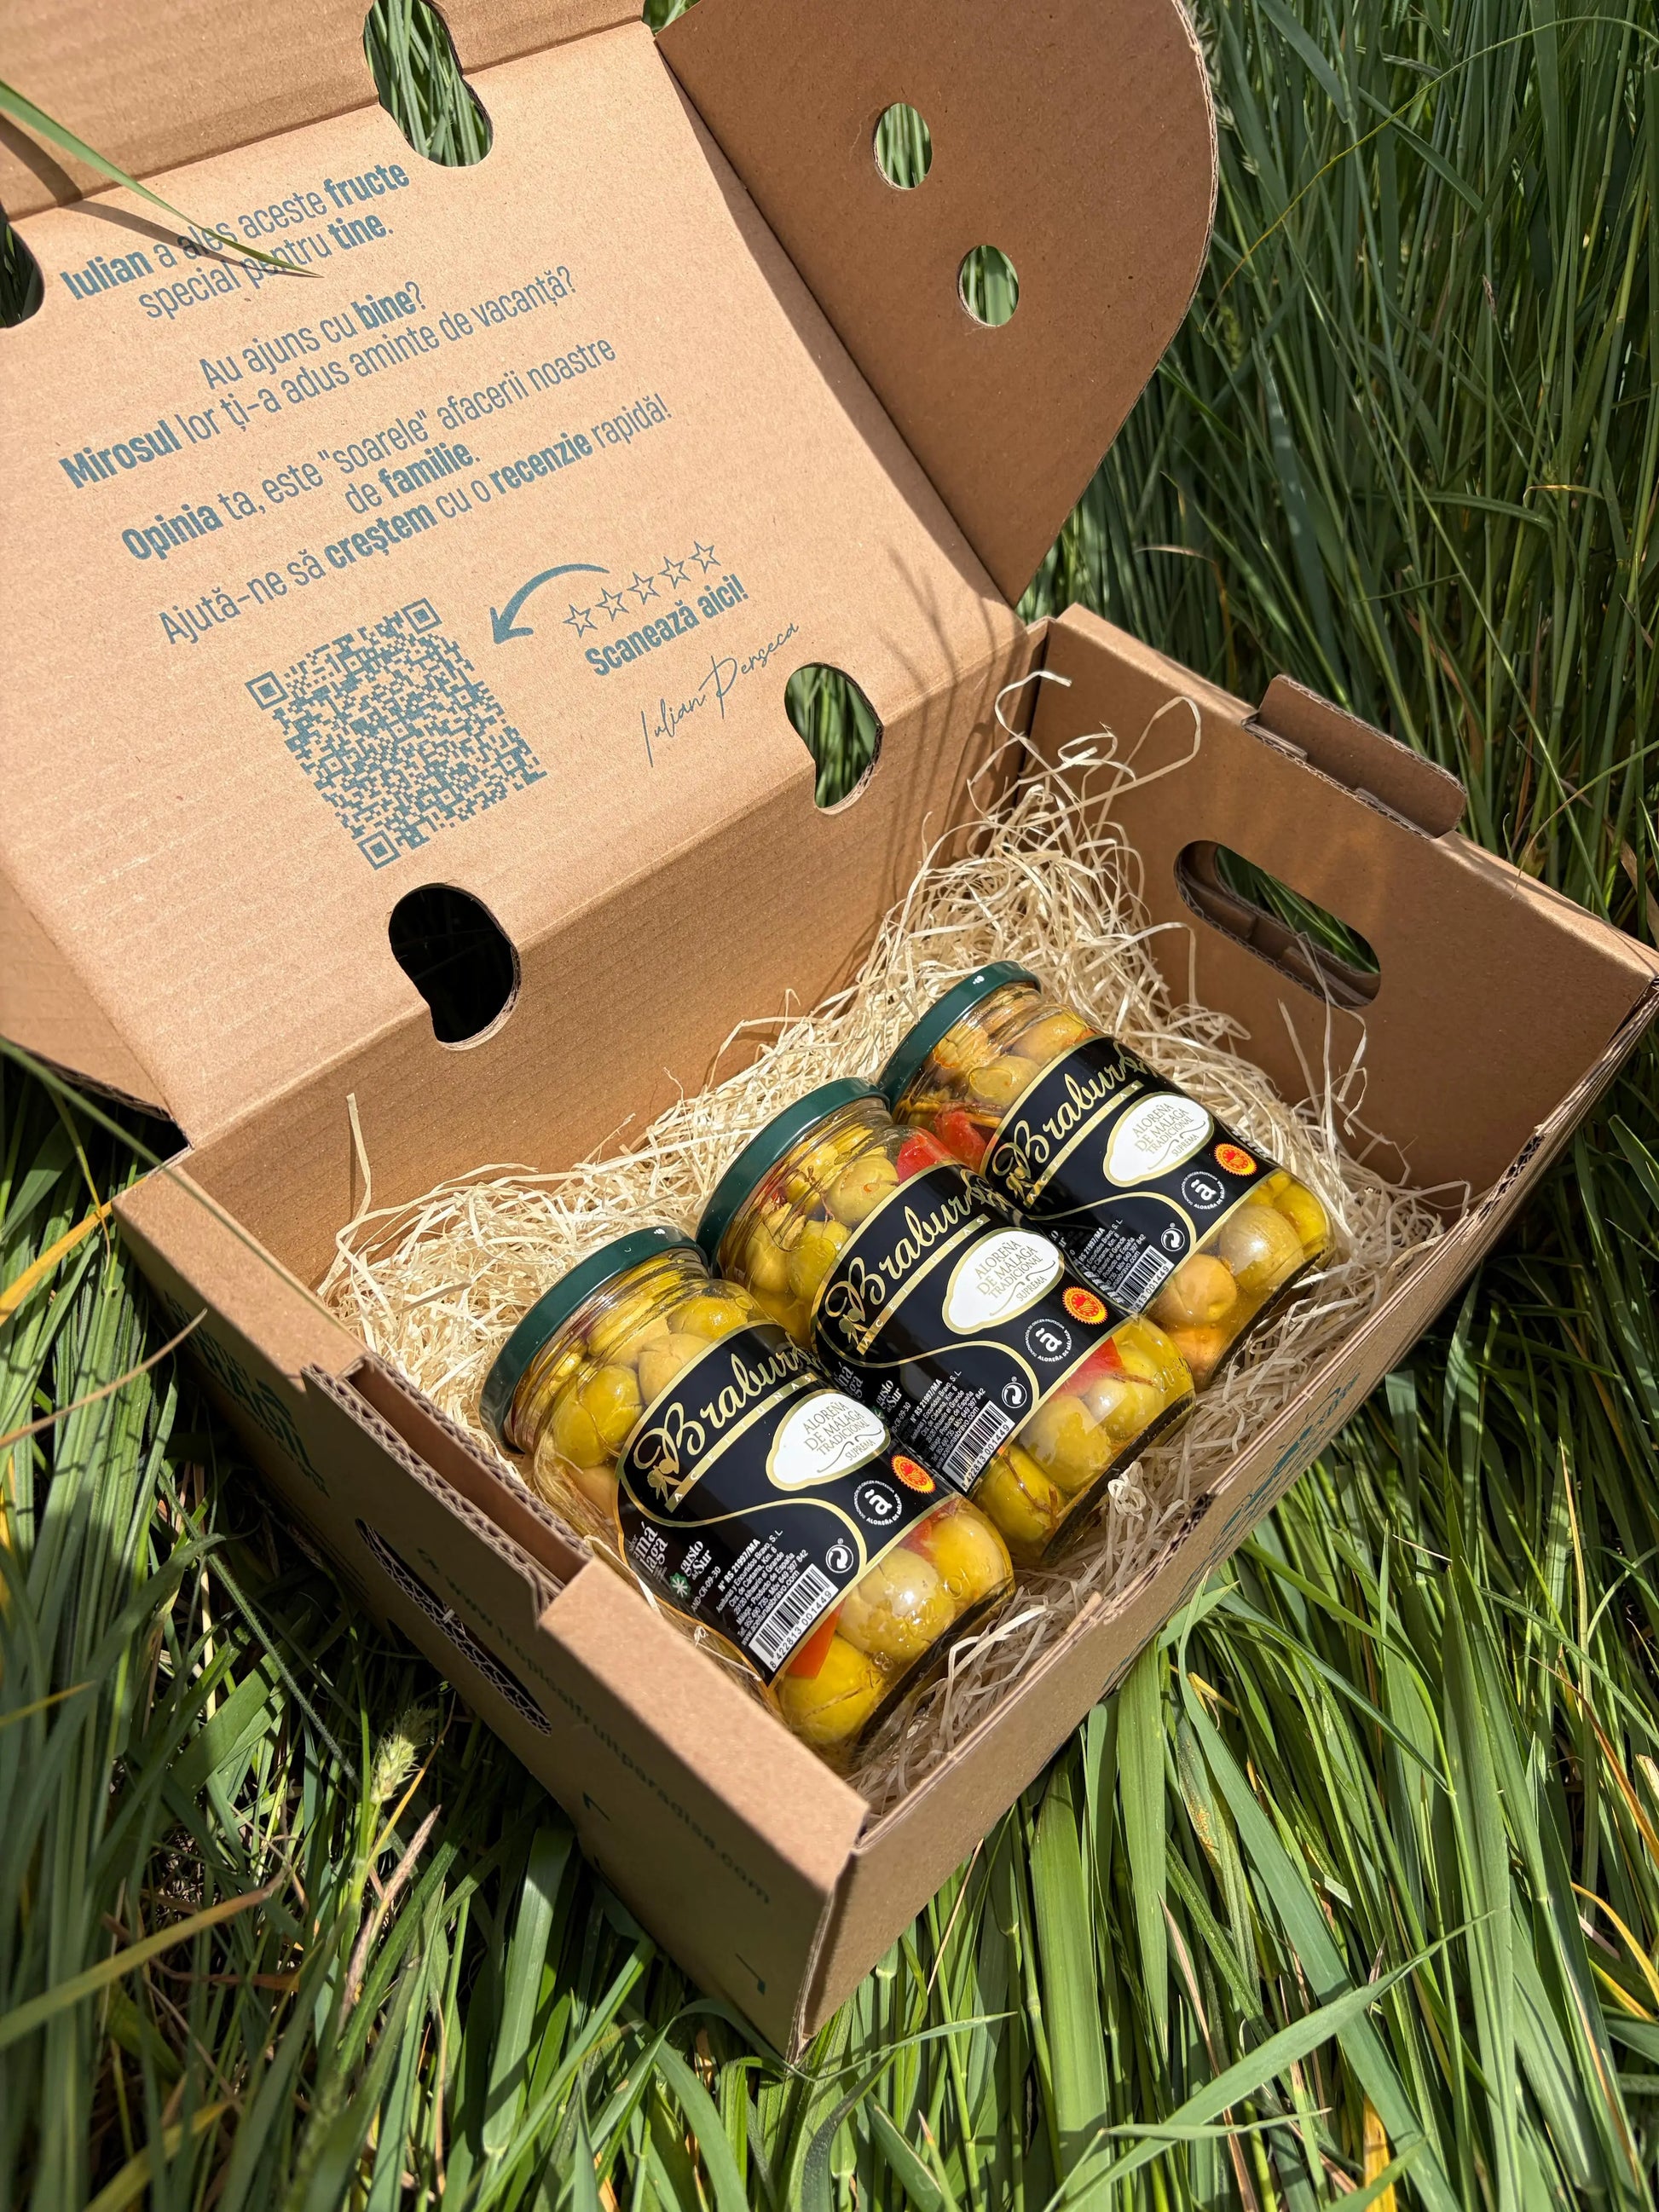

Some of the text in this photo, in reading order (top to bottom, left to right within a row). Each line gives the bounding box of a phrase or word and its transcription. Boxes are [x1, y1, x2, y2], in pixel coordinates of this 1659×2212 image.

[60, 164, 410, 300] Iulian a ales aceste fructe
[139, 212, 394, 320] special pentru tine.
[199, 281, 427, 390] Au ajuns cu bine?
[58, 420, 182, 489] Mirosul
[175, 407, 223, 445] lor
[280, 359, 350, 406] adus
[349, 322, 441, 378] aminte
[438, 310, 474, 342] de
[121, 338, 616, 560] Opinia ta, este "soarele" afacerii noastre
[344, 441, 481, 514] de familie.
[159, 570, 288, 645] Ajută-ne
[286, 548, 327, 586] să
[436, 488, 473, 520] cu
[471, 479, 492, 504] o
[488, 432, 593, 496] recenzie
[590, 392, 673, 450] rapidă!
[584, 574, 749, 676] Scanează aici!
[1131, 1102, 1173, 1138] ALOREÑA
[1135, 1108, 1190, 1152] DE MÁLAGA
[1146, 1115, 1195, 1154] TRADICIONAL
[1173, 1134, 1200, 1158] SUPREMA
[974, 1239, 1022, 1279] ALOREÑA
[1136, 1233, 1146, 1245] 842
[977, 1246, 1038, 1295] DE MÁLAGA
[988, 1255, 1044, 1300] TRADICIONAL
[1015, 1275, 1048, 1302] SUPREMA
[1147, 1265, 1170, 1293] 001449
[876, 1380, 893, 1409] gusto
[886, 1388, 902, 1407] Sur
[939, 1415, 956, 1435] Producto
[957, 1390, 974, 1410] España
[948, 1389, 964, 1408] Grande
[966, 1397, 977, 1411] 397
[974, 1388, 986, 1400] 842
[673, 1374, 812, 1503] ACEITUNAS
[803, 1401, 847, 1435] ALOREÑA
[804, 1410, 865, 1451] DE MÁLAGA
[817, 1420, 870, 1456] TRADICIONAL
[985, 1424, 1010, 1455] 001449
[845, 1438, 876, 1462] SUPREMA
[680, 1541, 703, 1576] gusto
[694, 1550, 712, 1574] Sur
[715, 1588, 734, 1613] Aceitunas
[734, 1557, 757, 1586] Encurtidos
[754, 1542, 772, 1560] Bravo,
[724, 1570, 734, 1583] RS
[731, 1539, 760, 1573] 21997/MA
[737, 1586, 745, 1595] de
[761, 1553, 773, 1564] Km.
[744, 1577, 763, 1600] Alhaurín
[765, 1551, 784, 1573] Grande
[751, 1580, 772, 1604] Producto
[769, 1572, 777, 1582] de
[775, 1552, 795, 1574] España
[758, 1597, 771, 1611] 735
[777, 1570, 789, 1583] 649
[786, 1559, 797, 1573] 397
[795, 1549, 808, 1562] 842
[691, 1566, 720, 1611] AND-CR-09-30
[777, 1626, 802, 1660] 422813
[802, 1591, 832, 1626] 001449
